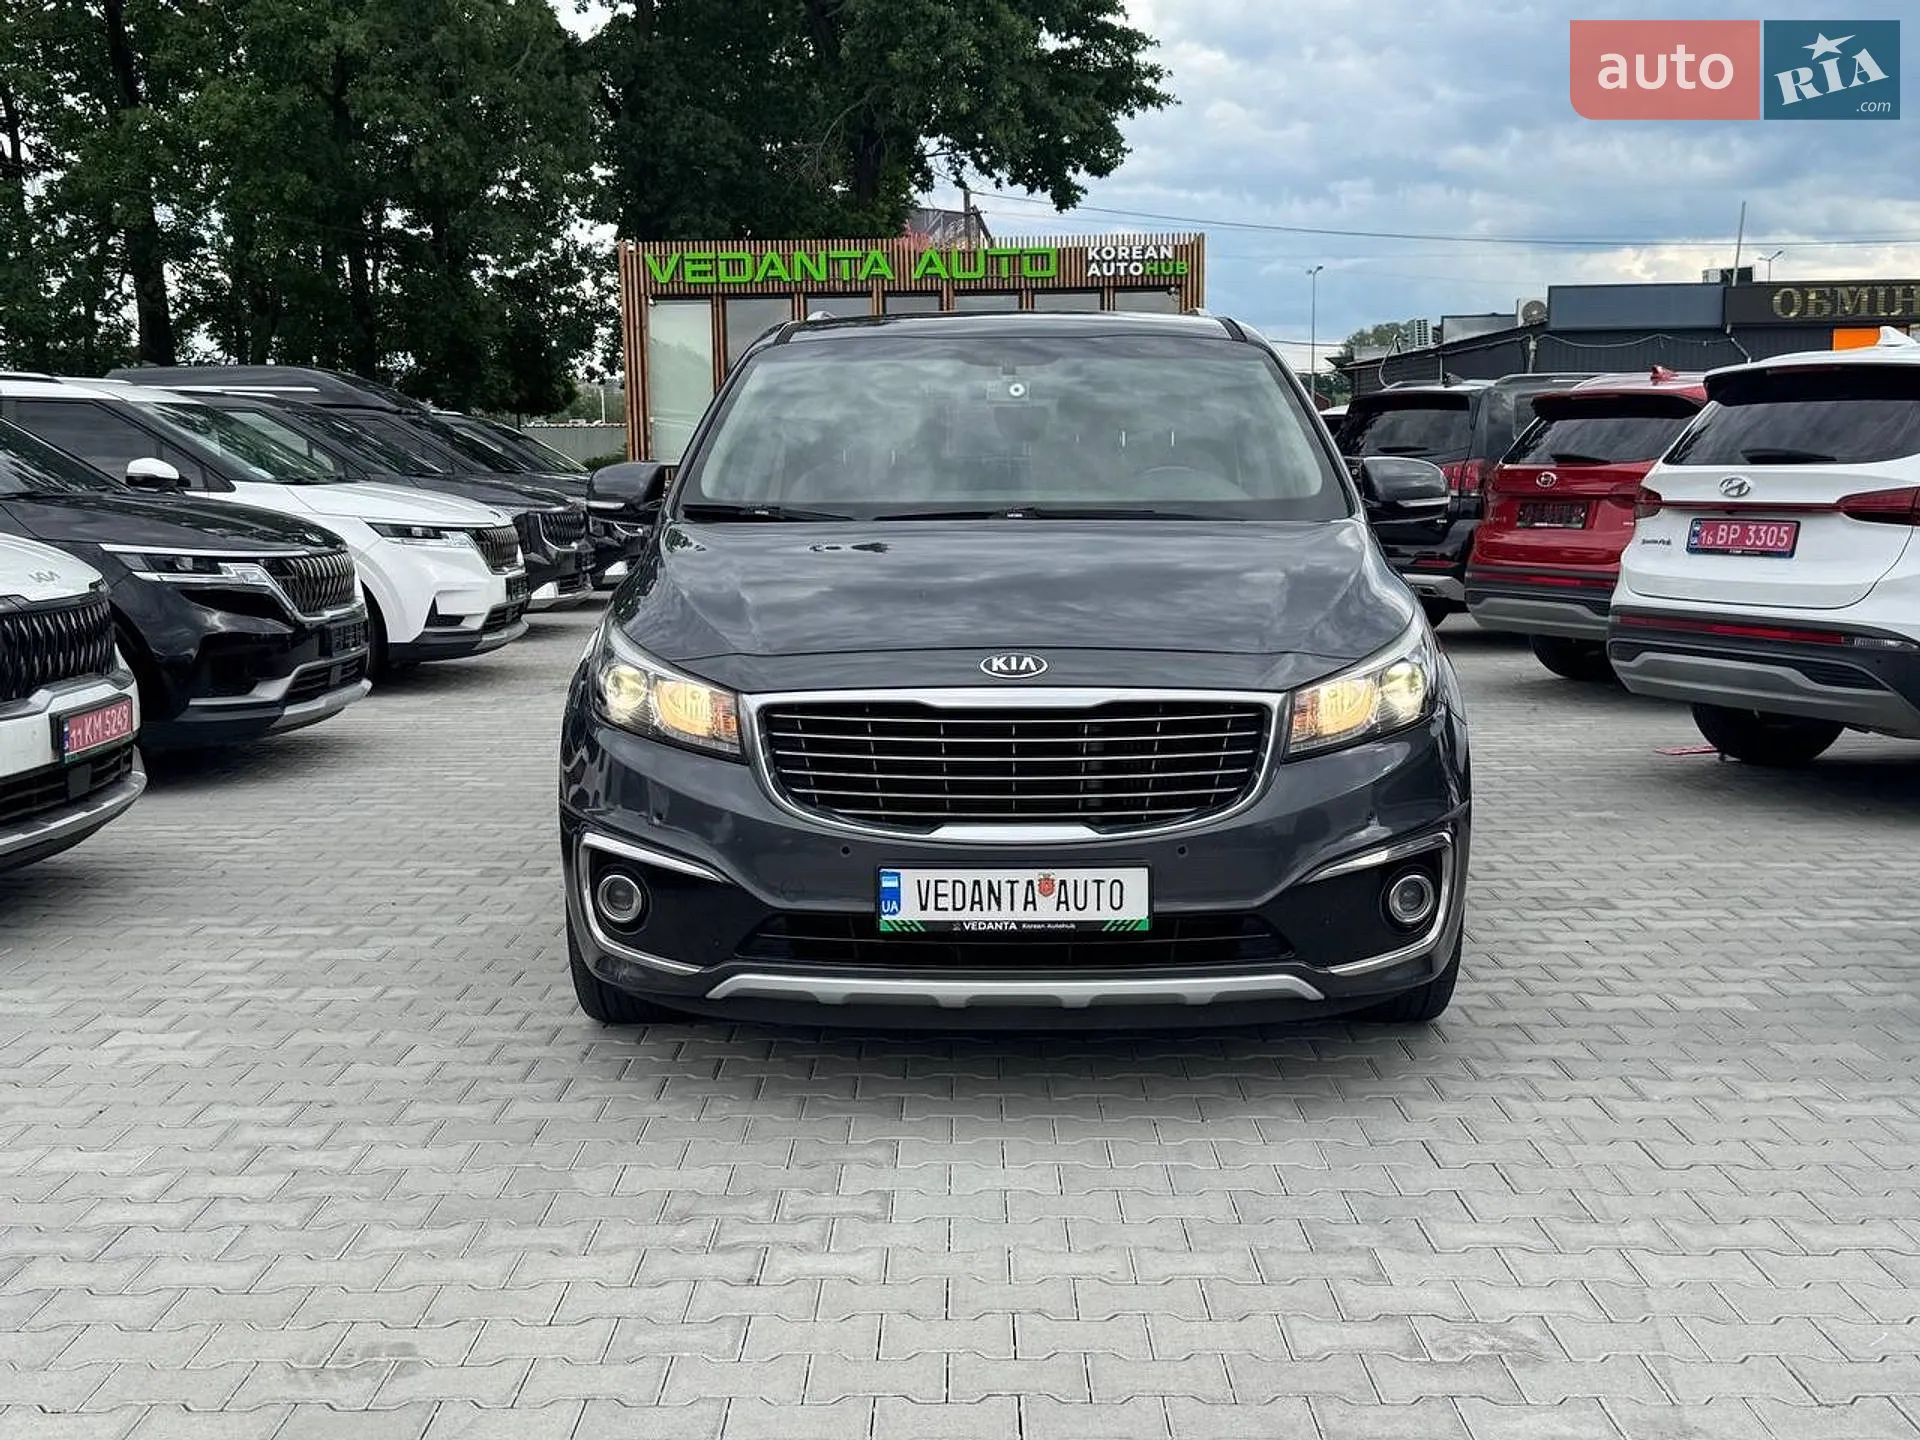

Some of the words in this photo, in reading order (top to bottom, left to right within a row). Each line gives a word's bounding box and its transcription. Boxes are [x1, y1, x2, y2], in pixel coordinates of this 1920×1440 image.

[1087, 245, 1173, 260] KOREAN
[645, 249, 894, 284] VEDANTA
[915, 247, 1057, 281] AUTO
[1716, 525, 1741, 545] BP
[1745, 526, 1790, 547] 3305
[991, 656, 1037, 672] KIA
[85, 713, 103, 744] KM
[916, 878, 1038, 912] VEDANTA
[1055, 878, 1124, 912] AUTO
[881, 901, 899, 915] UA
[963, 921, 1018, 931] VEDANTA
